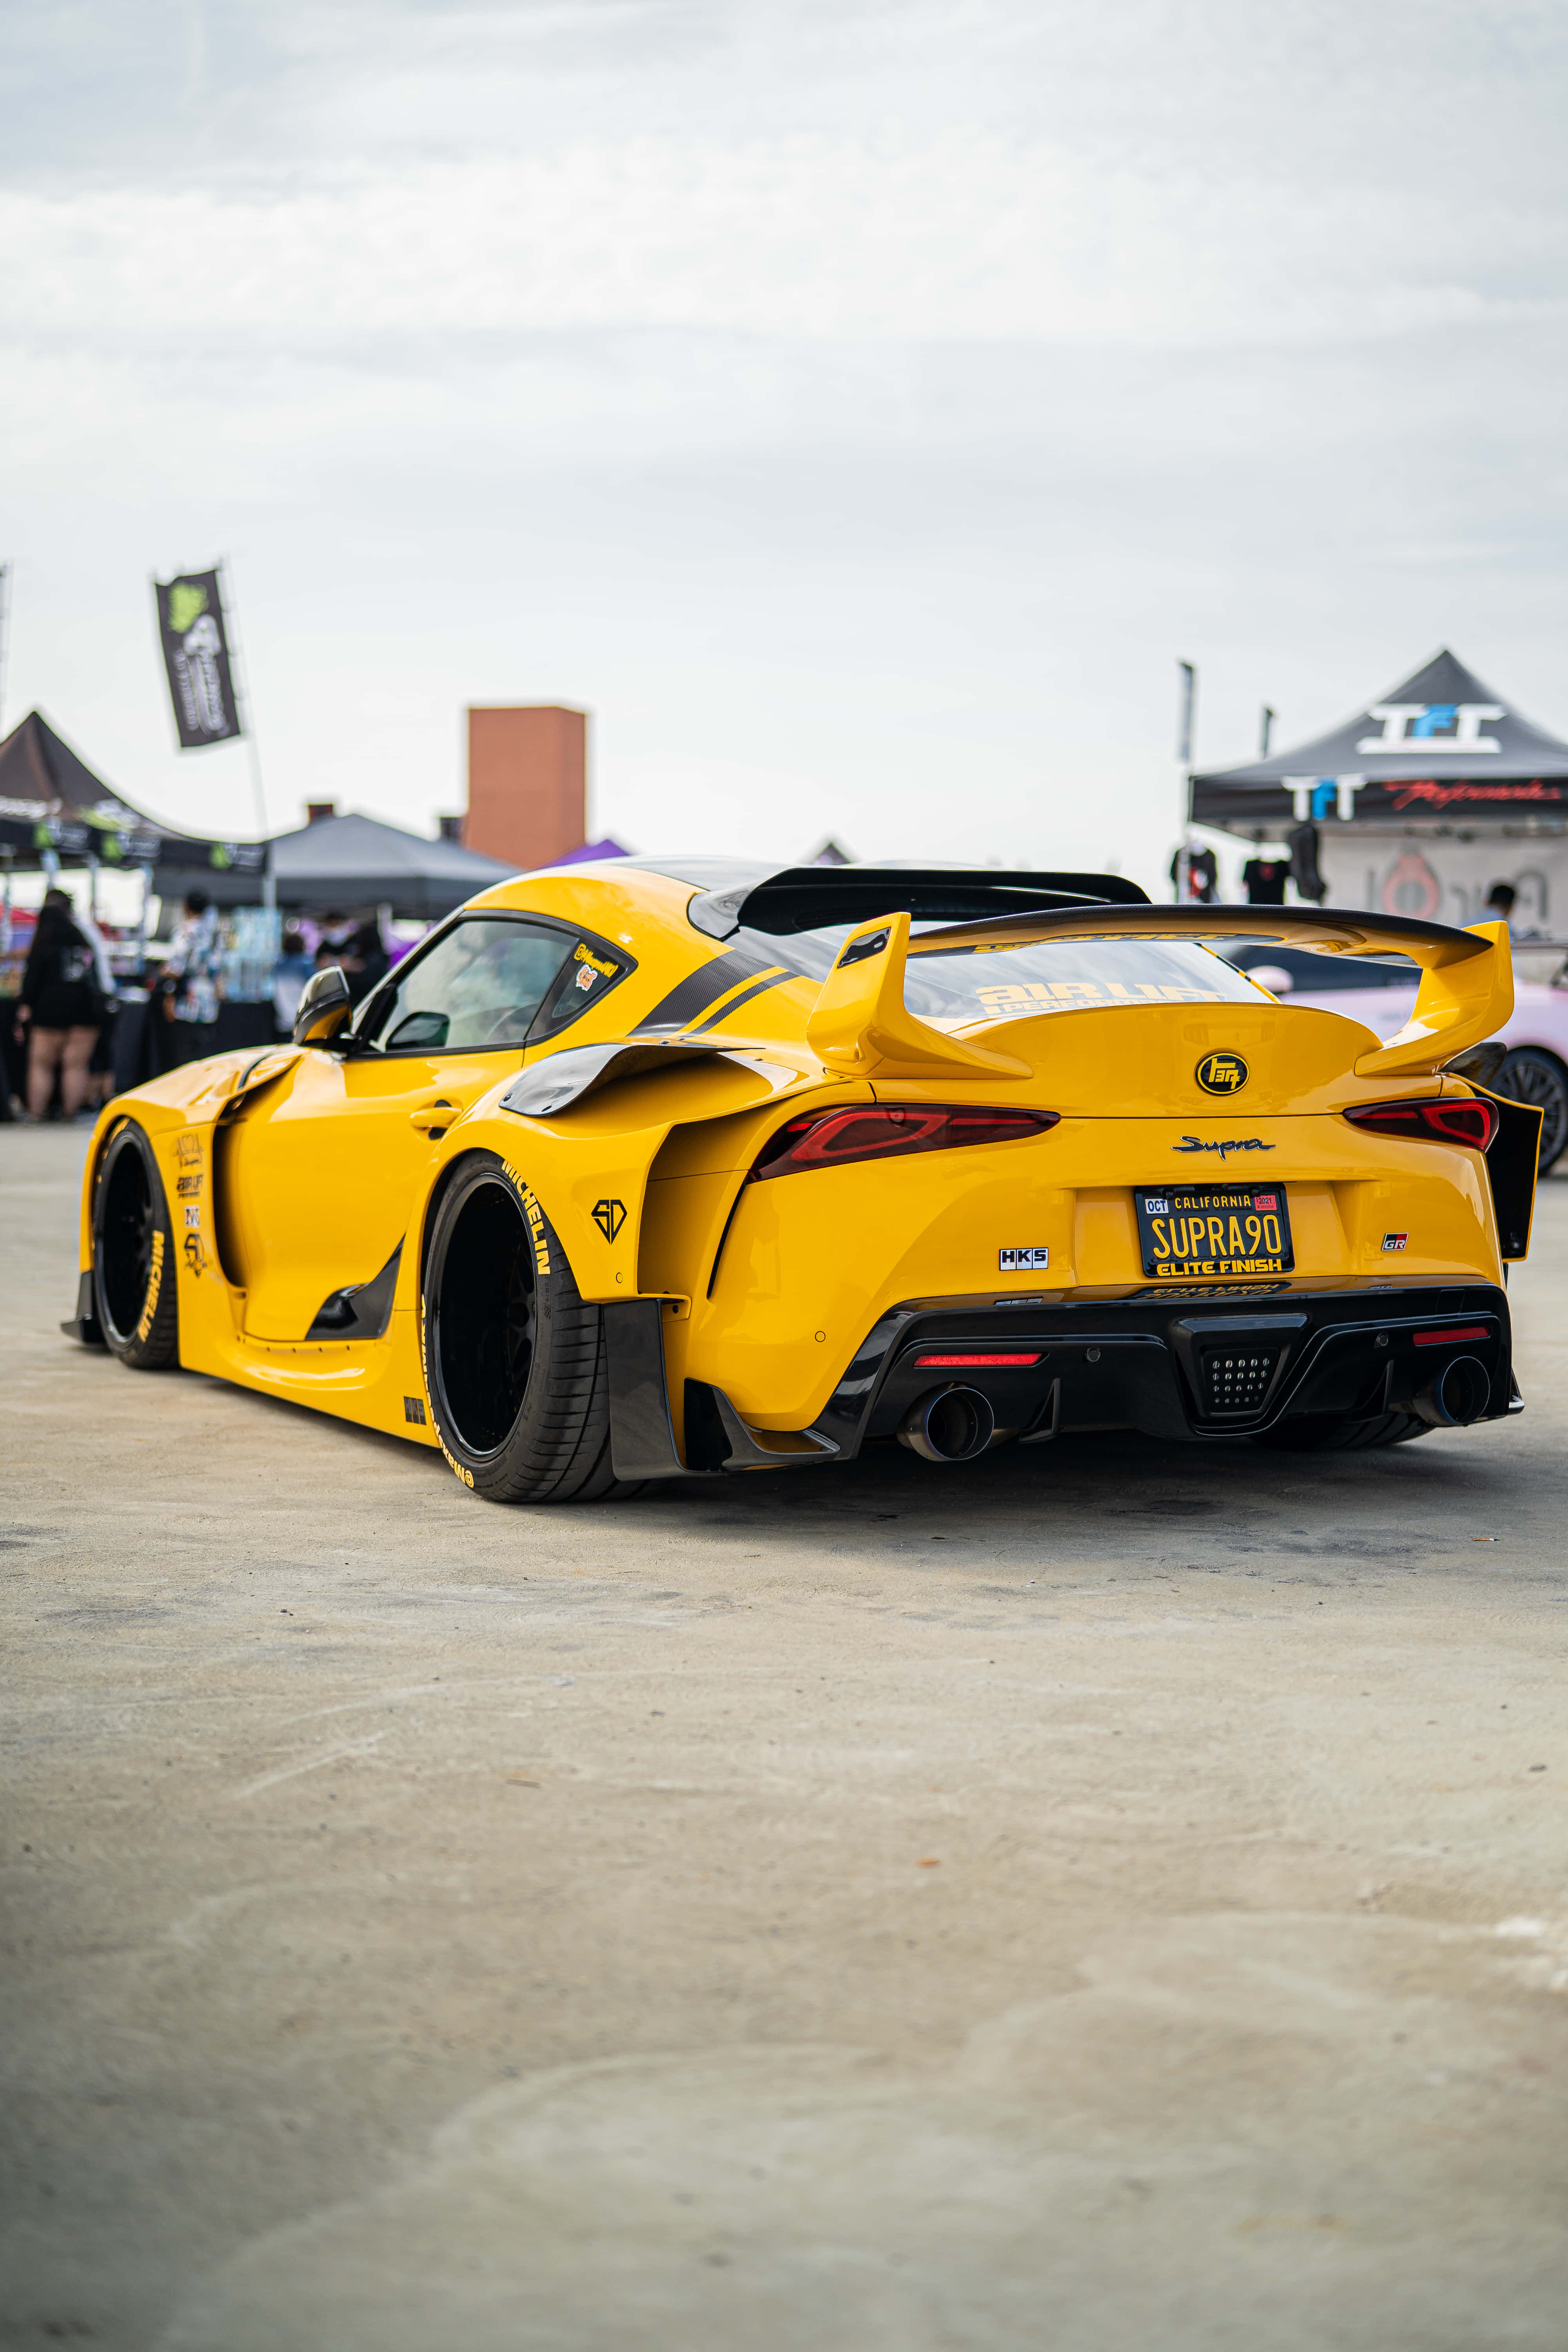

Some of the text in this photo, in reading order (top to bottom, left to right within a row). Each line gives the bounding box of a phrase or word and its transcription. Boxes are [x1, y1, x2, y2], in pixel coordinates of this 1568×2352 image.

[1171, 1136, 1277, 1161] Supra
[1148, 1200, 1166, 1212] OCT
[1175, 1195, 1251, 1209] CALIFORNIA
[501, 1159, 551, 1275] MICHELIN
[1152, 1214, 1282, 1259] SUPRA90
[1384, 1240, 1406, 1249] GR
[1002, 1249, 1047, 1264] HKS
[1157, 1259, 1282, 1276] ELITE FINISH
